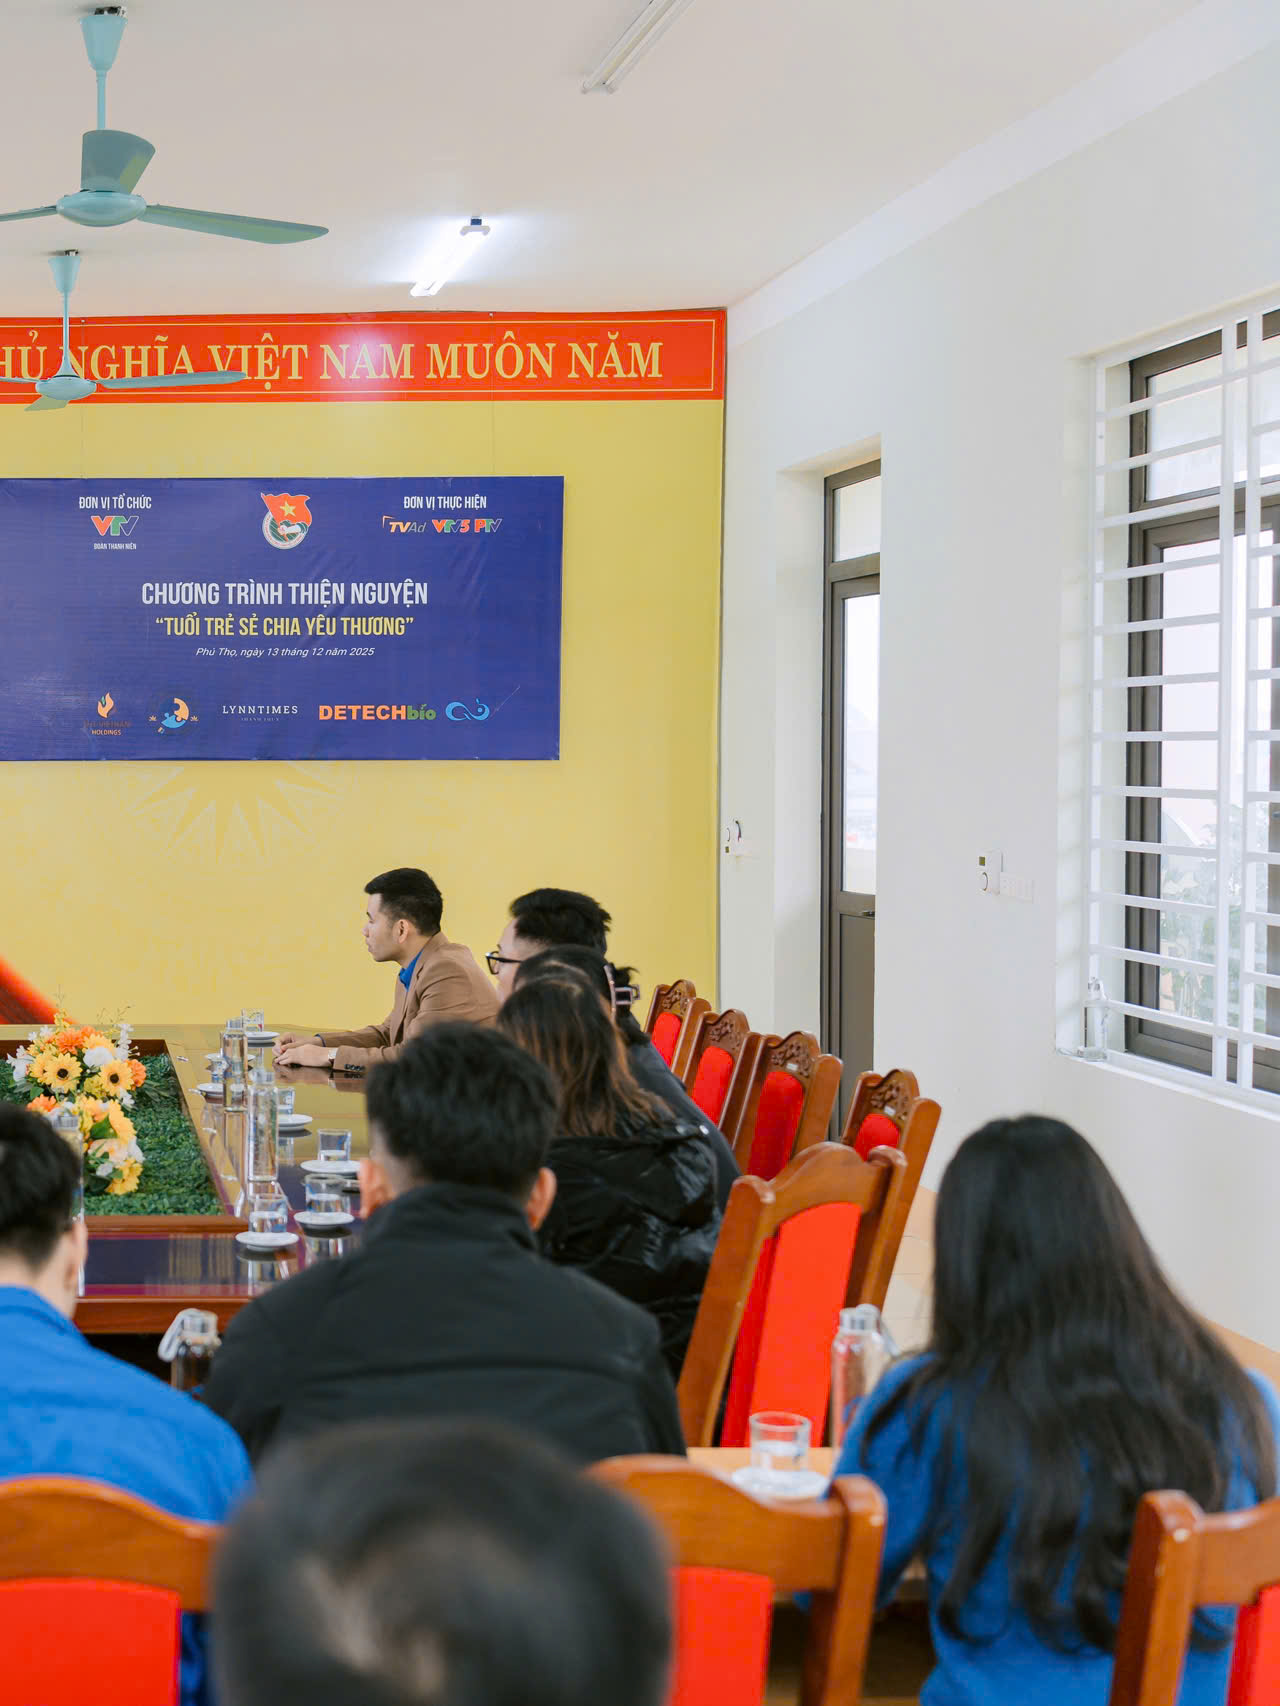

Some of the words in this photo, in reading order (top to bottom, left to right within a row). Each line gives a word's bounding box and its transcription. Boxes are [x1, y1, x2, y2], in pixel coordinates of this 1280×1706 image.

[207, 332, 309, 391] VIỆT
[319, 343, 415, 380] NAM
[425, 330, 557, 380] MUÔN
[567, 330, 664, 379] NĂM
[79, 496, 98, 509] ĐƠN
[100, 496, 110, 510] VỊ
[112, 493, 126, 509] TỔ
[126, 494, 152, 509] CHỨC
[403, 495, 424, 509] ĐƠN
[425, 496, 436, 511] VỊ
[437, 495, 463, 511] THỰC
[464, 493, 487, 511] HIỆN
[91, 516, 139, 536] VTV
[431, 518, 471, 534] VTV5
[141, 581, 221, 606] CHƯƠNG
[224, 578, 283, 606] TRÌNH
[287, 578, 345, 609] THIỆN
[350, 578, 429, 609] NGUYỆN
[155, 611, 200, 636] “TUỔI
[204, 612, 235, 636] TRẺ
[238, 612, 259, 636] SẺ
[263, 616, 301, 636] CHIA
[305, 613, 337, 636] YÊU
[340, 616, 415, 636] THƯƠNG”
[195, 647, 216, 656] Phú
[218, 647, 238, 658] Thọ,
[240, 648, 265, 659] ngày
[267, 647, 279, 656] 13
[281, 647, 310, 658] tháng
[312, 647, 324, 656] 12
[325, 648, 348, 656] năm
[349, 647, 376, 656] 2025
[222, 705, 299, 715] LYNNTIMES
[318, 703, 437, 721] DETECHbio
